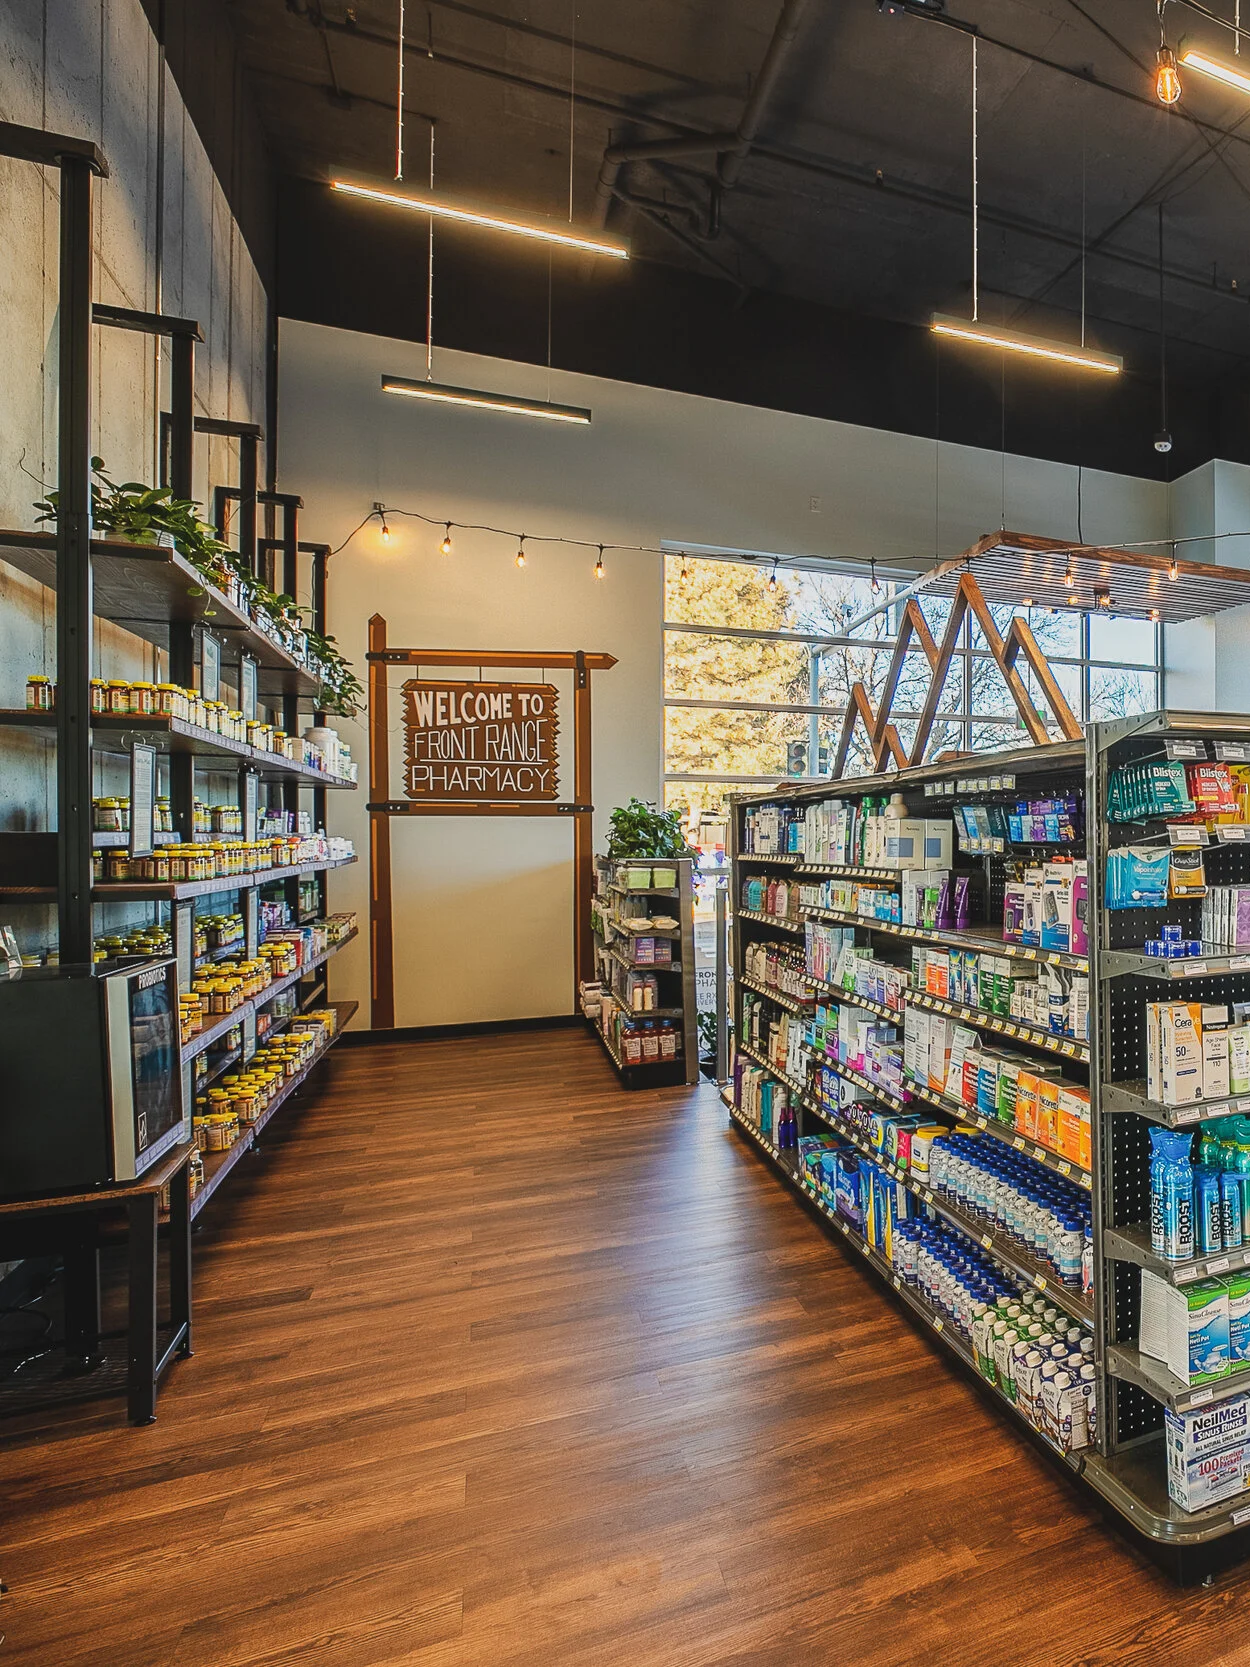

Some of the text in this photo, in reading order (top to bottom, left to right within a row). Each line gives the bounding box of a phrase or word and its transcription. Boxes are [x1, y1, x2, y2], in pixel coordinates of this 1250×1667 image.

[412, 691, 544, 728] WELCOME TO
[414, 718, 549, 762] FRONT RANGE
[411, 765, 549, 793] PHARMACY
[1153, 767, 1228, 779] Blistex Blistex
[138, 966, 167, 990] PROBIOTICS
[1175, 1045, 1187, 1057] 50
[1179, 1199, 1190, 1245] BOOST
[1211, 1201, 1220, 1241] BOOST
[1192, 1404, 1247, 1432] NeilMed
[1197, 1419, 1244, 1441] SINUS RINSE
[1203, 1438, 1222, 1450] NATURAL
[1222, 1435, 1234, 1444] SINUS
[1219, 1447, 1245, 1462] Premixed
[1219, 1456, 1242, 1468] Packets
[1197, 1457, 1219, 1476] 100
